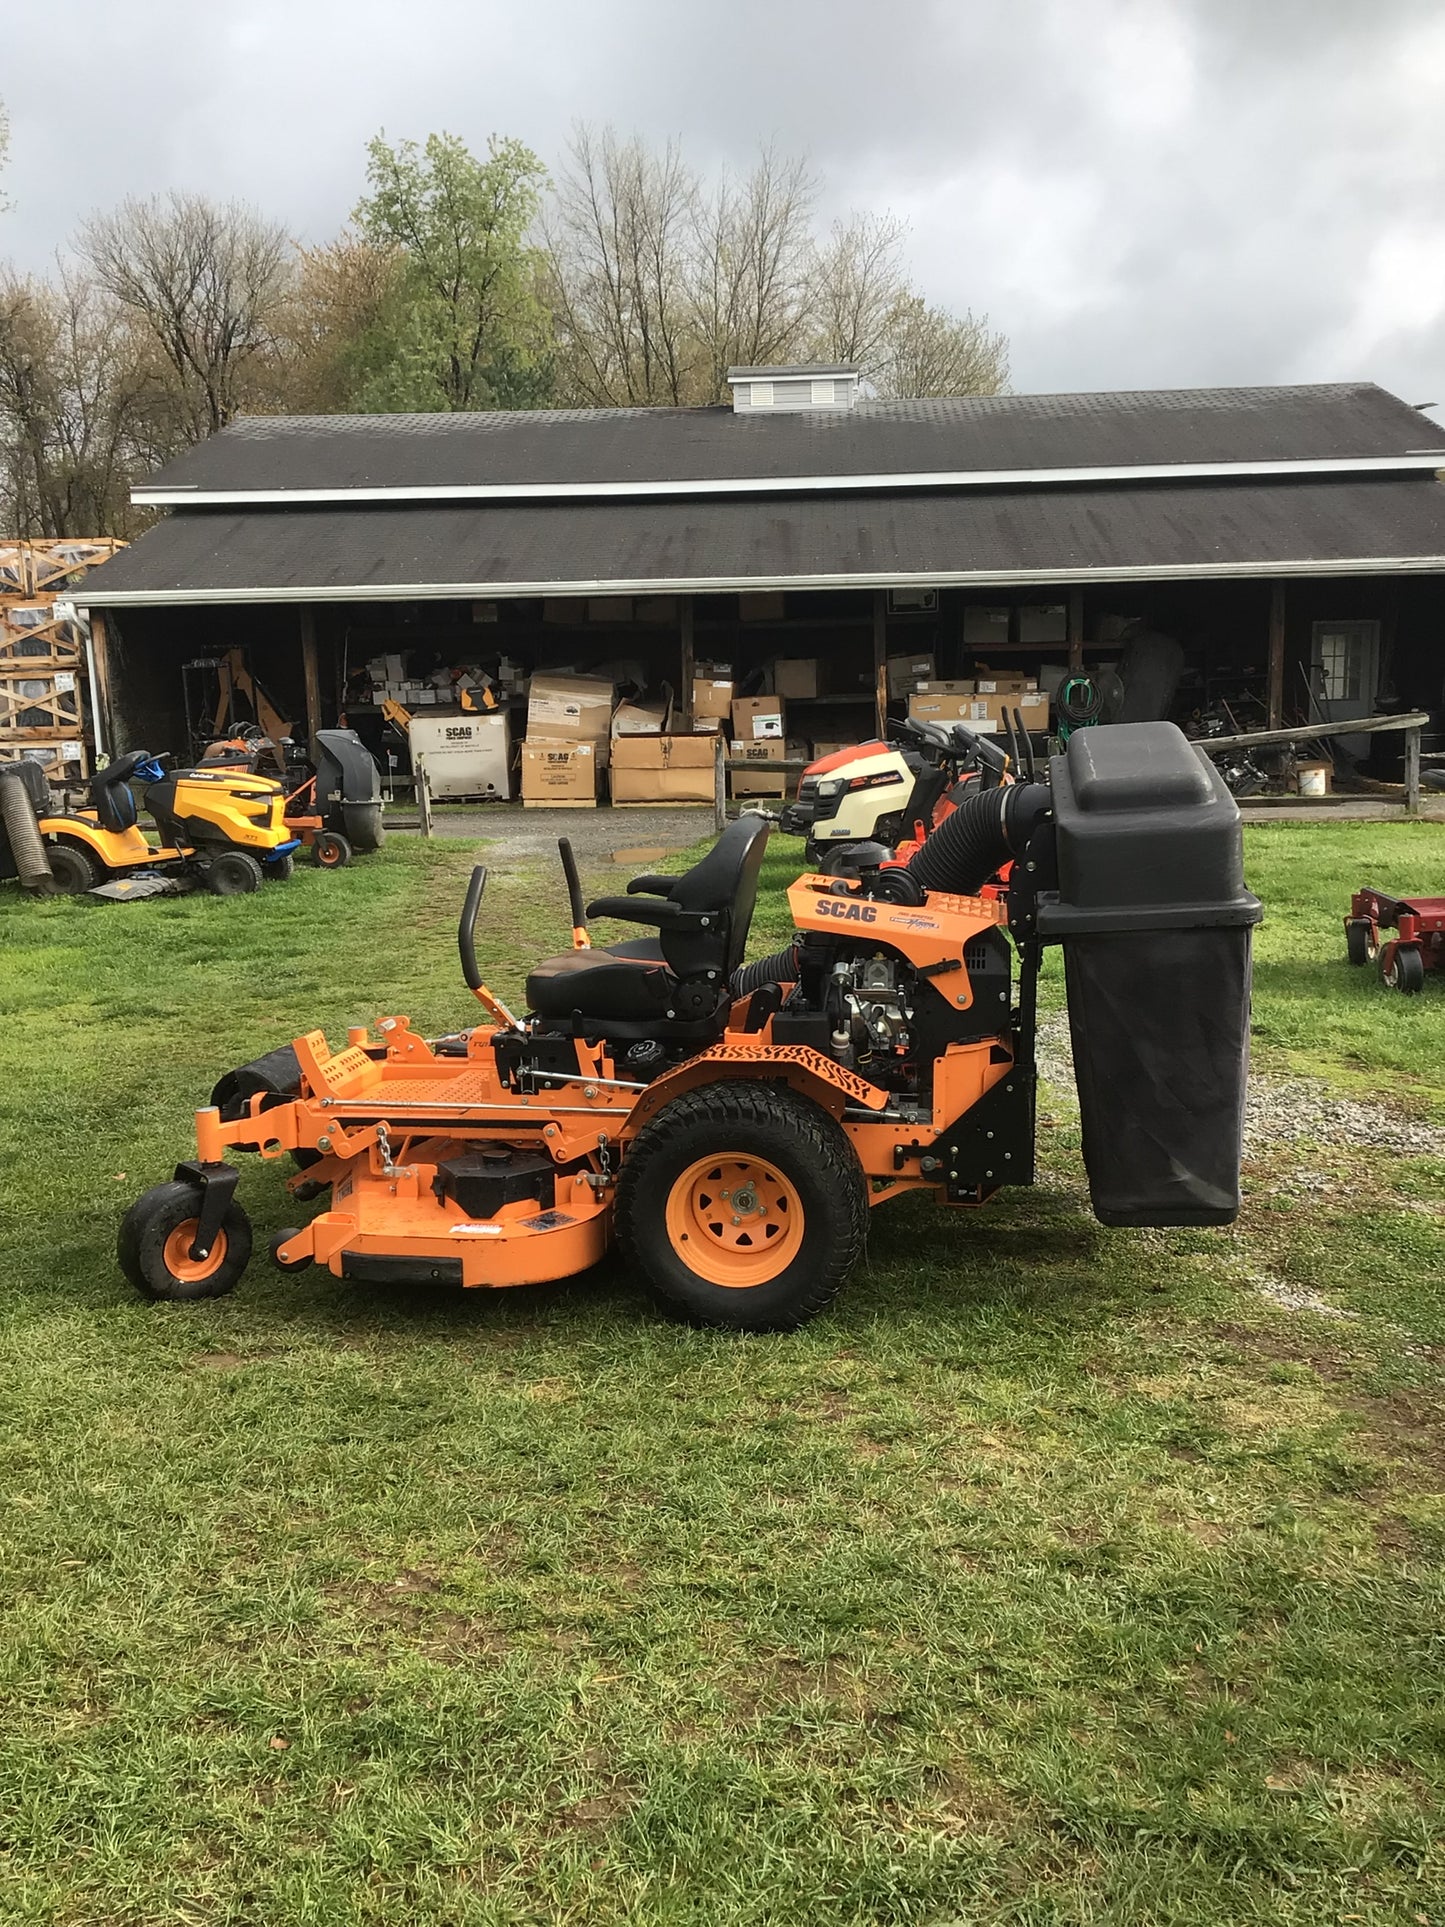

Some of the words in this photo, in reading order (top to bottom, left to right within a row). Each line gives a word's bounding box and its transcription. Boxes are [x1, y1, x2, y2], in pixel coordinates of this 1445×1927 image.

[445, 726, 472, 737] SCAG
[547, 752, 569, 761] SCAG
[747, 748, 768, 757] SCAG
[815, 898, 878, 923] SCAG
